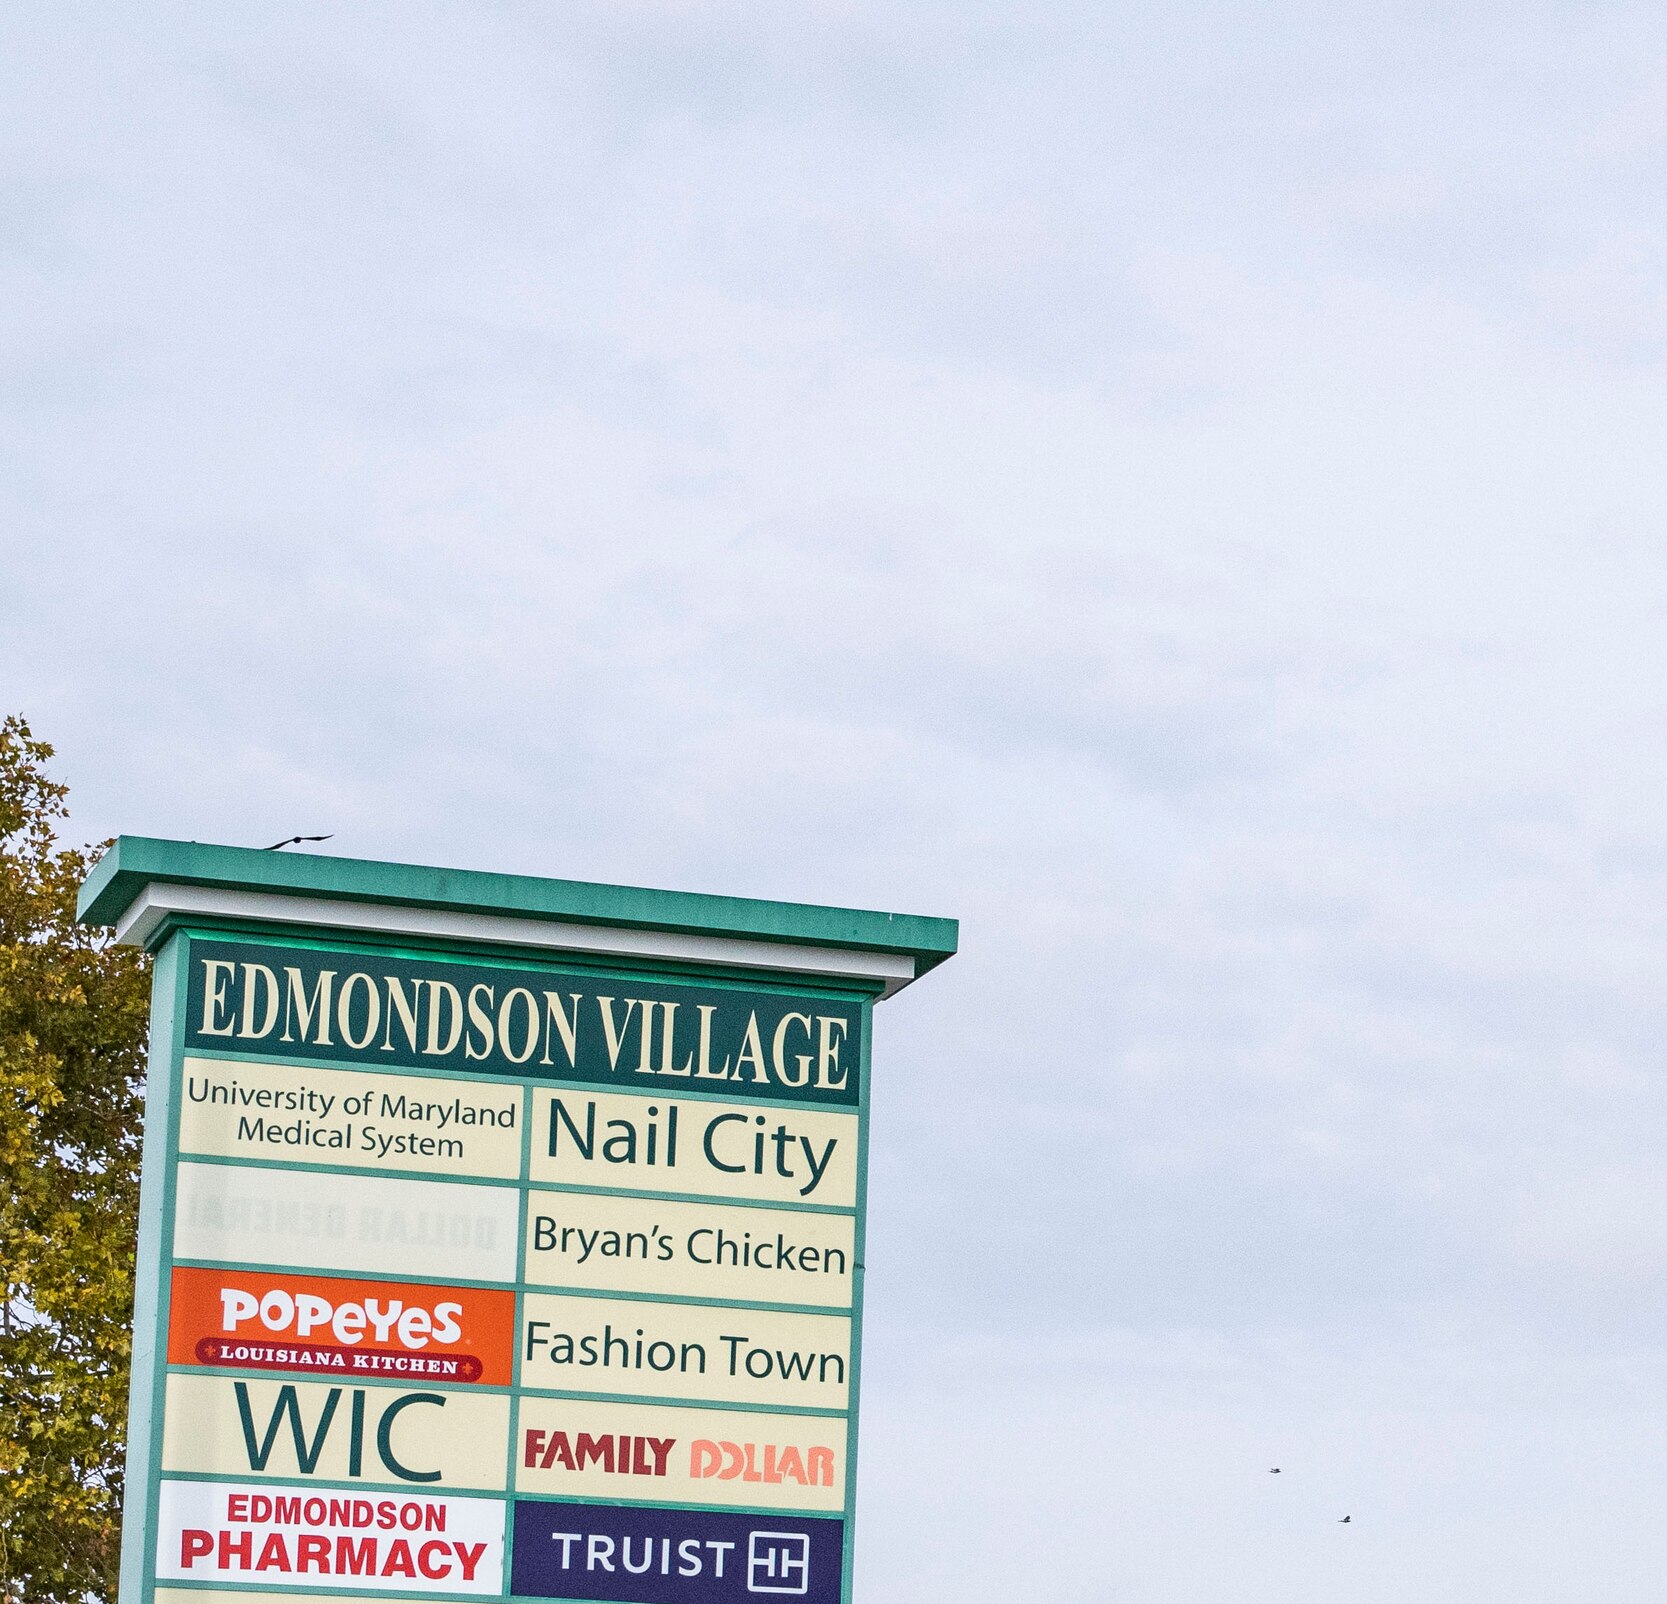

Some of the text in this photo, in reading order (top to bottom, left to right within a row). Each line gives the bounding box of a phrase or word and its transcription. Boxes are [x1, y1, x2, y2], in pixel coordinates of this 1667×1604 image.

[197, 958, 849, 1091] EDMONDSON VILLAGE
[188, 1077, 516, 1129] University of Maryland
[237, 1116, 464, 1159] Medical System
[548, 1098, 838, 1197] Nail City
[534, 1216, 846, 1275] Bryan's Chicken
[220, 1345, 459, 1375] LOUISIANA KITCHEN
[526, 1320, 845, 1384] Fashion Town
[233, 1381, 447, 1483] WIC
[524, 1429, 835, 1487] FAMILY DOLLAR
[227, 1493, 447, 1532] EDMONDSON
[180, 1528, 488, 1581] PHARMACY
[551, 1532, 735, 1578] TRUIST
